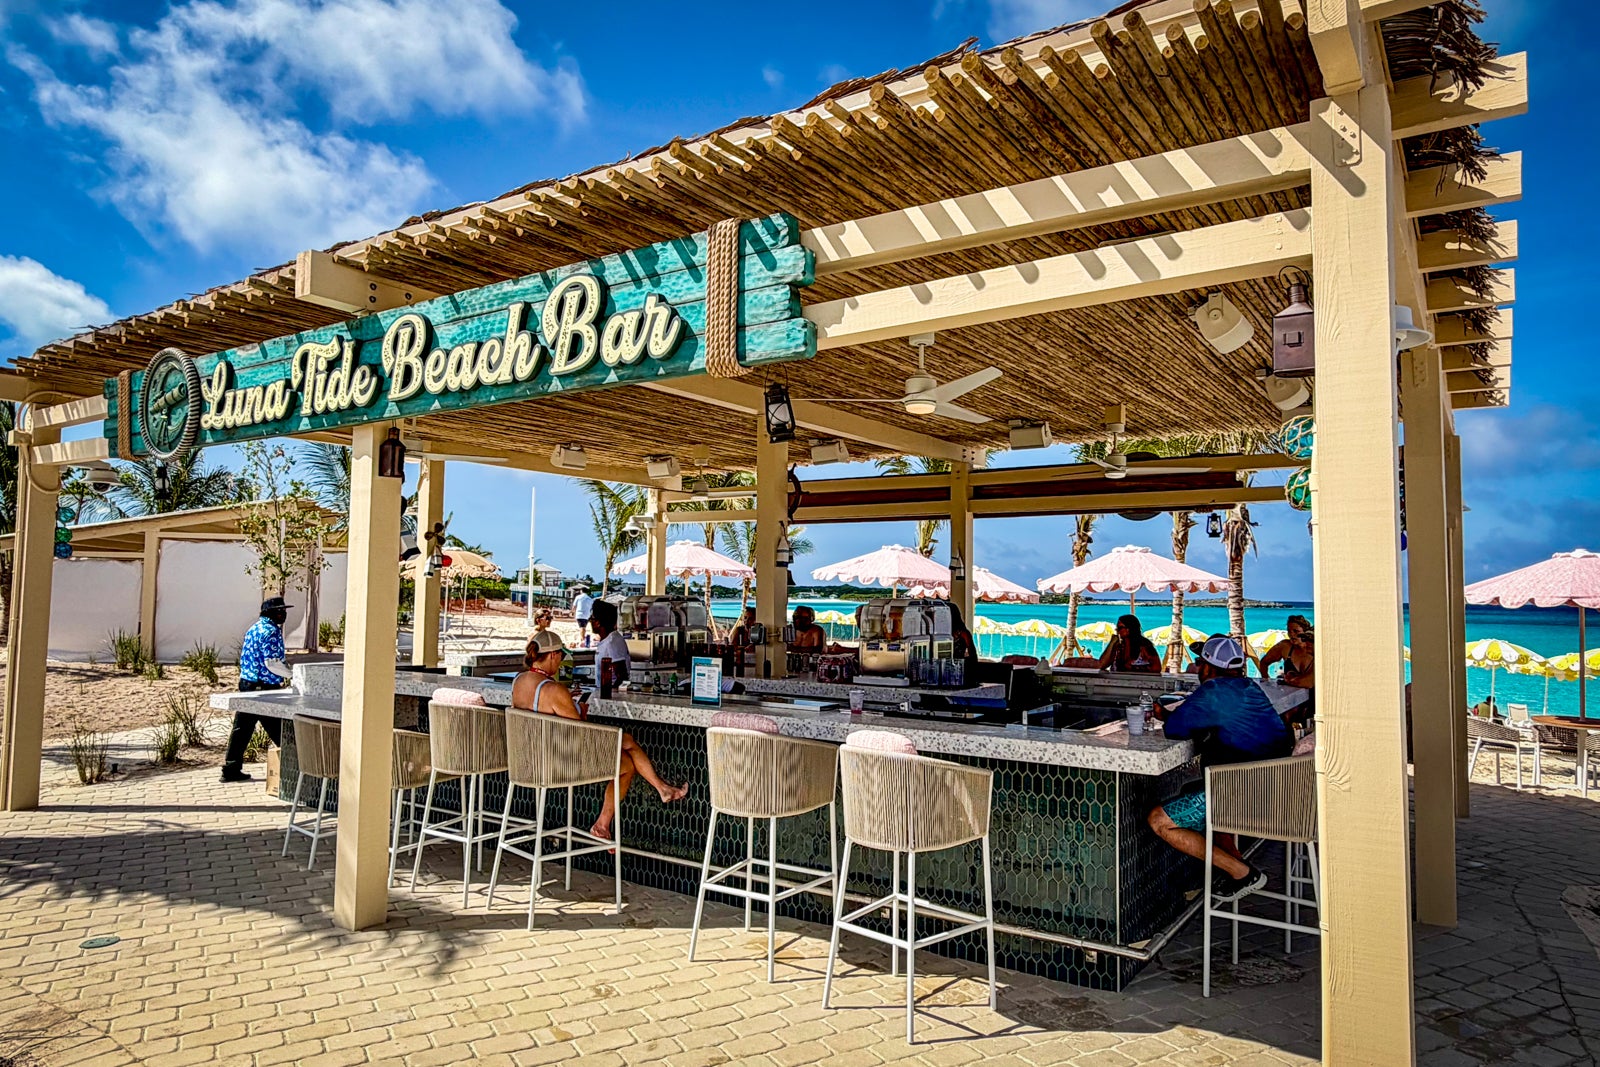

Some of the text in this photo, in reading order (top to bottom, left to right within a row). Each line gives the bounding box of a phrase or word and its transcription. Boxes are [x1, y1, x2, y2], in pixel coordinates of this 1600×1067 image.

[200, 273, 682, 429] Luna Tide Beach Bar
